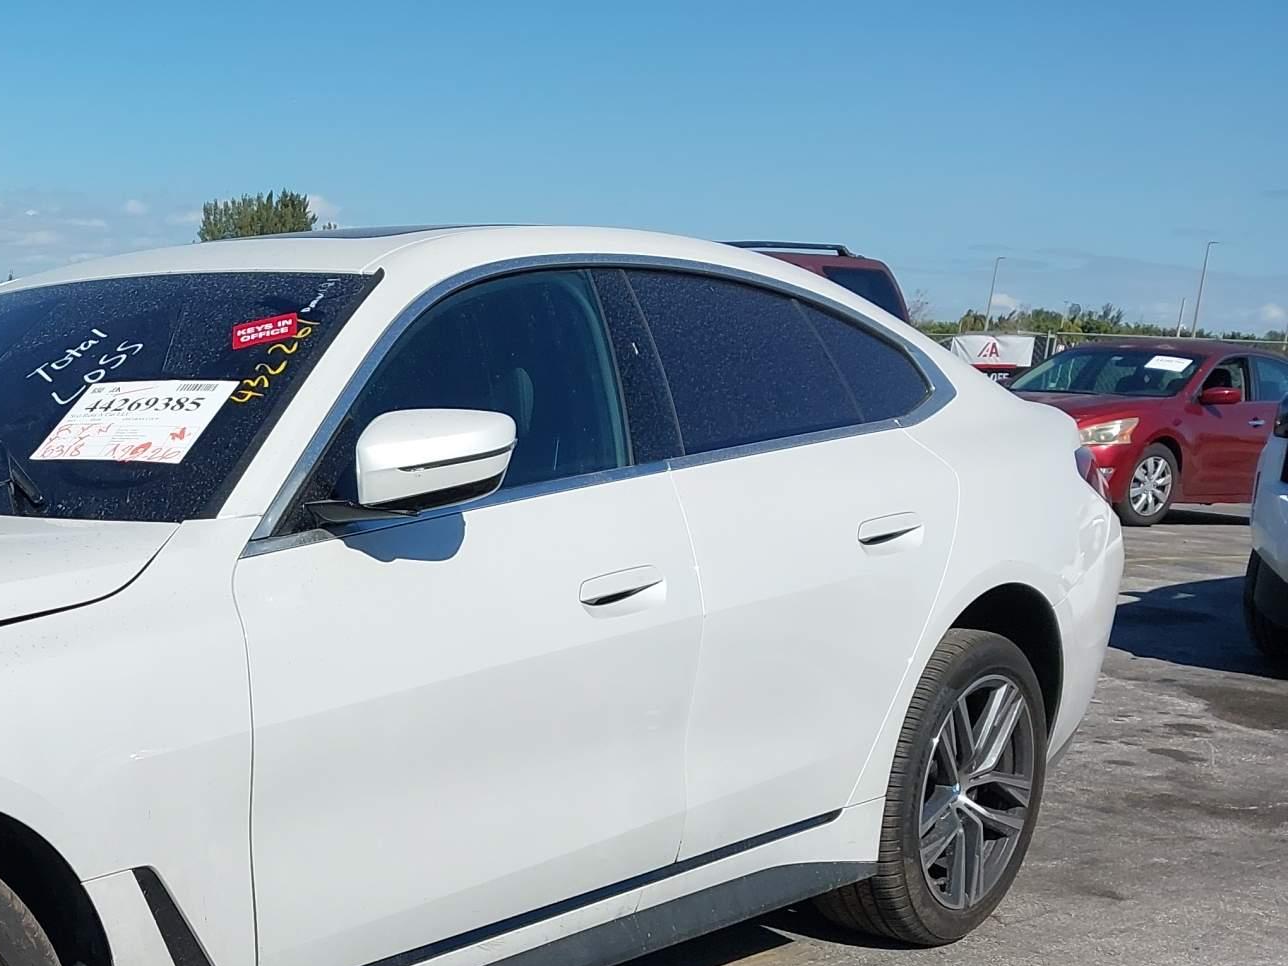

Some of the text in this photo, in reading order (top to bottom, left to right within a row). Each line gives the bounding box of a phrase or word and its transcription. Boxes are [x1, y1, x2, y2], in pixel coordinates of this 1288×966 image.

[236, 318, 293, 337] KEYS IN
[239, 326, 289, 343] OFFICE
[25, 328, 108, 383] Total
[85, 397, 206, 413] 44269385
